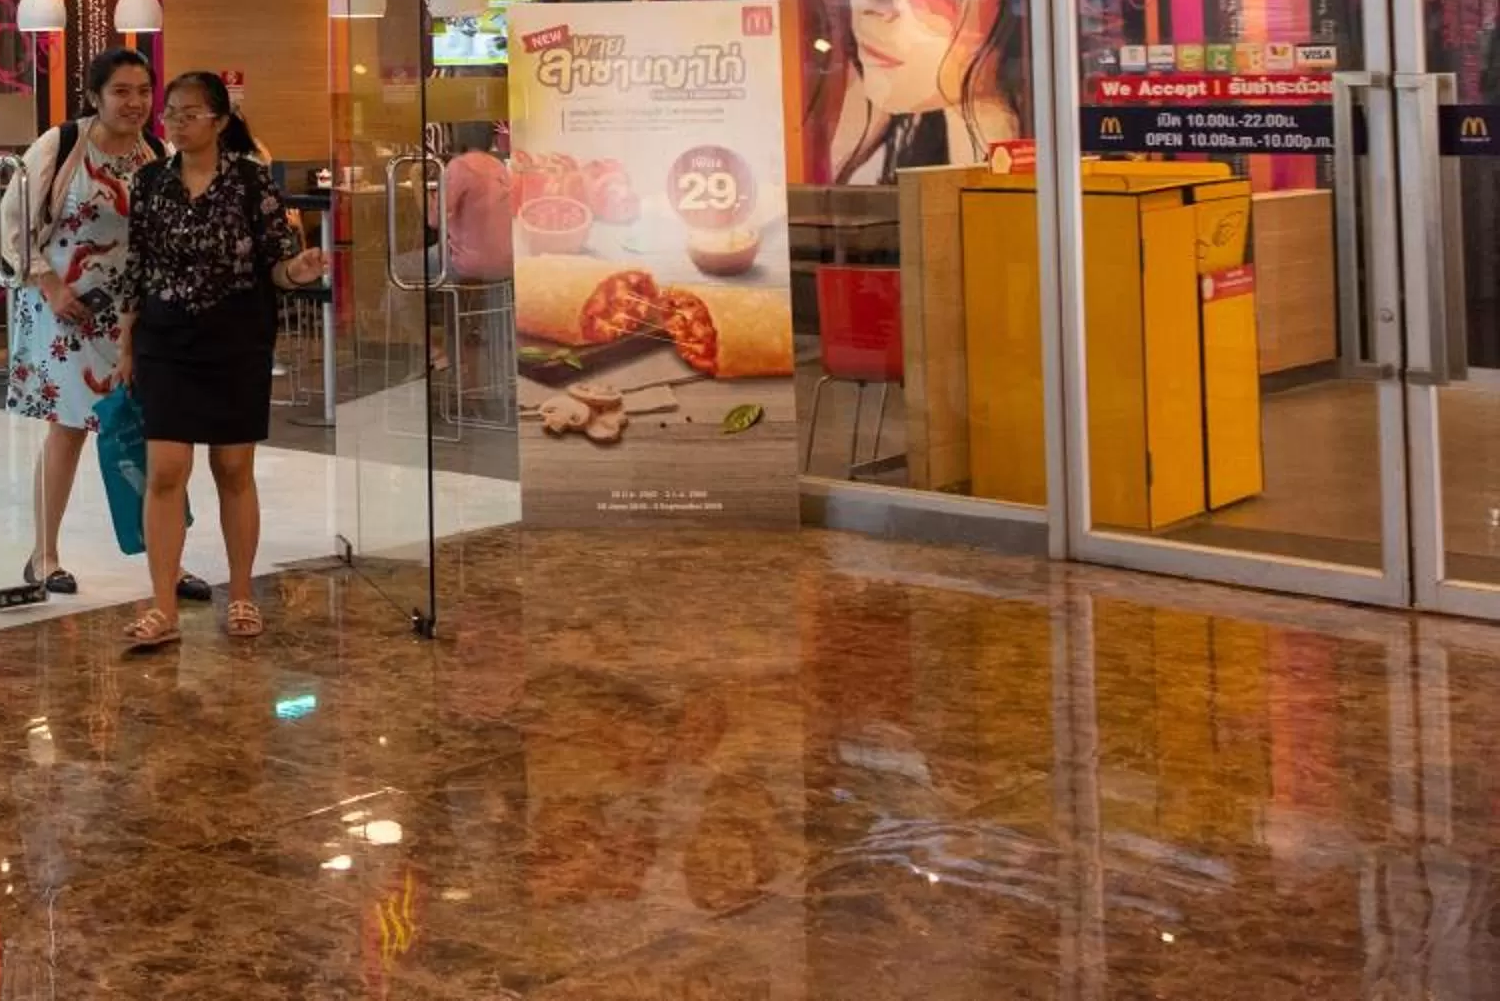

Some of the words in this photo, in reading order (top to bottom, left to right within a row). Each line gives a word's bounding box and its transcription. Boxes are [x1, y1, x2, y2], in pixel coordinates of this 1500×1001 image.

[531, 30, 562, 48] NEW
[1101, 80, 1131, 97] We
[1138, 79, 1208, 98] Accept
[1145, 132, 1183, 147] OPEN
